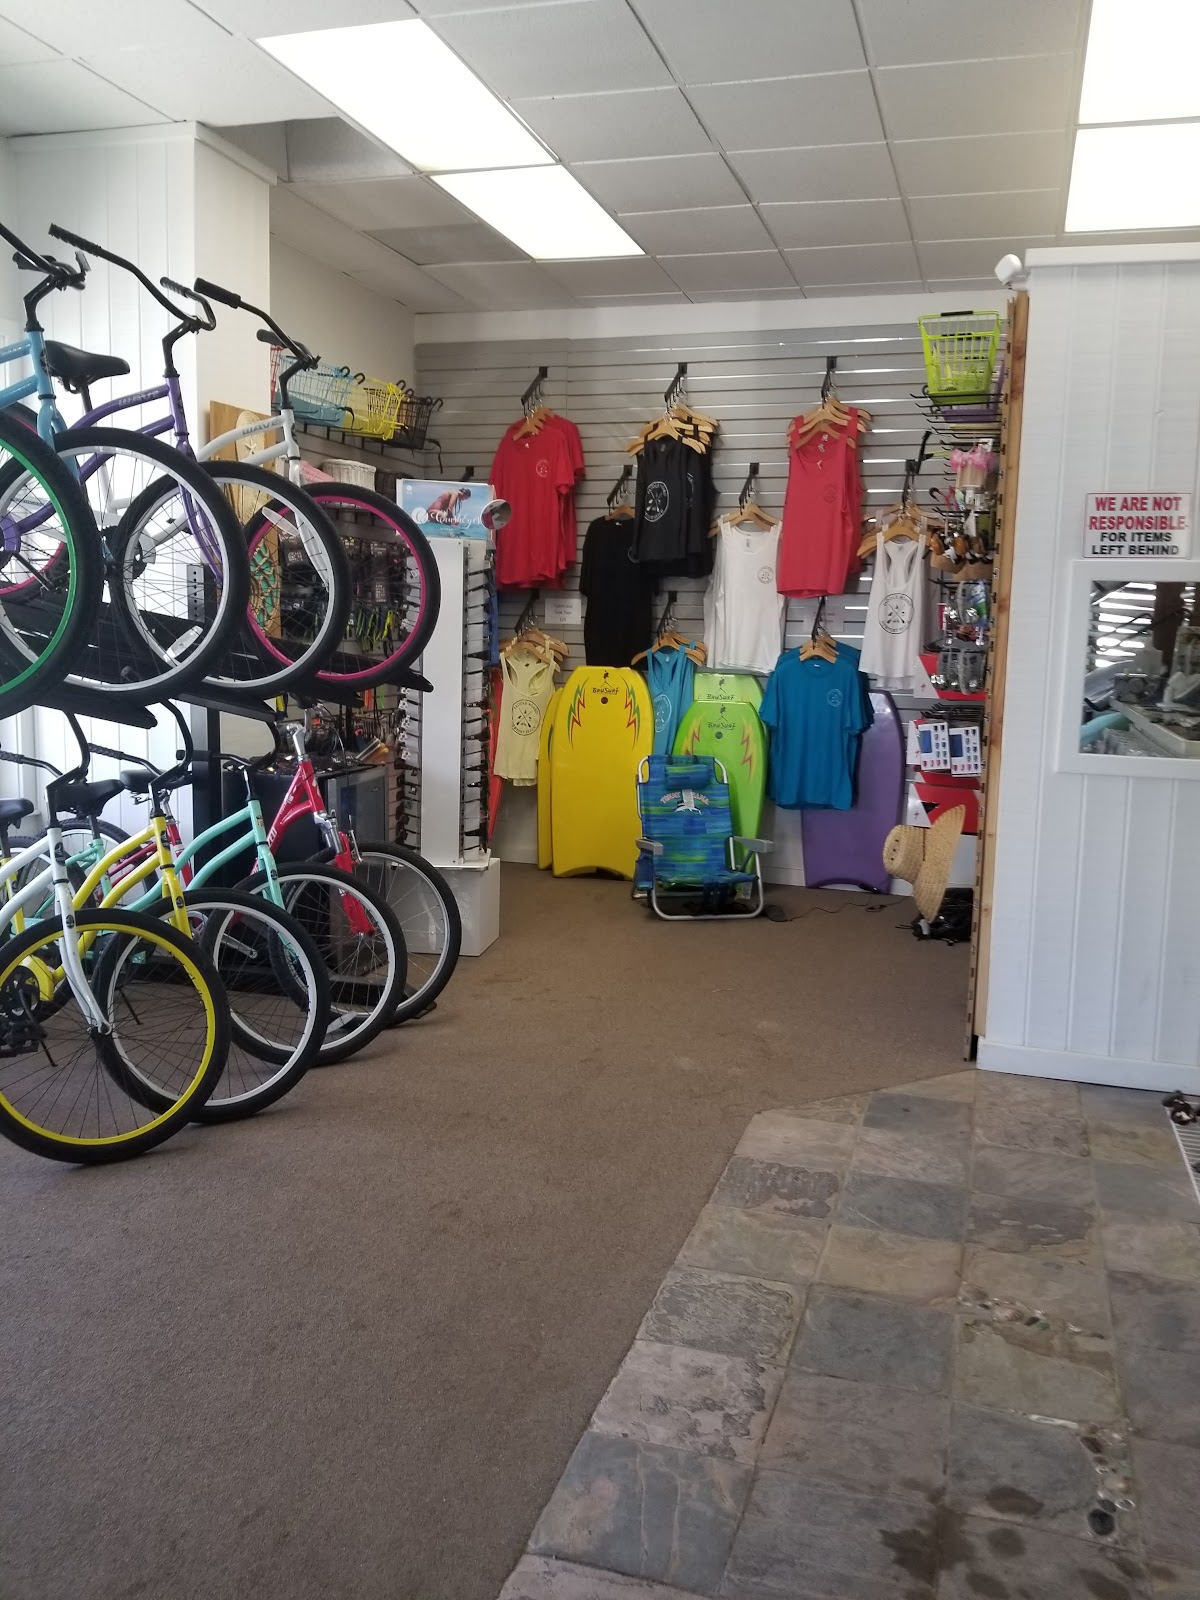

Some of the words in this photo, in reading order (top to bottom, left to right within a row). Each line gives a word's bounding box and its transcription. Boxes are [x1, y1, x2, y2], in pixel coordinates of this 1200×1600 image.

[1095, 497, 1116, 511] WE
[1120, 497, 1148, 511] ARE
[1152, 497, 1182, 511] NOT
[1089, 516, 1186, 530] RESPONSIBLE
[1100, 532, 1127, 542] FOR
[1131, 532, 1172, 542] ITEMS
[1092, 545, 1124, 555] LEFT
[1128, 545, 1179, 555] BEHIND
